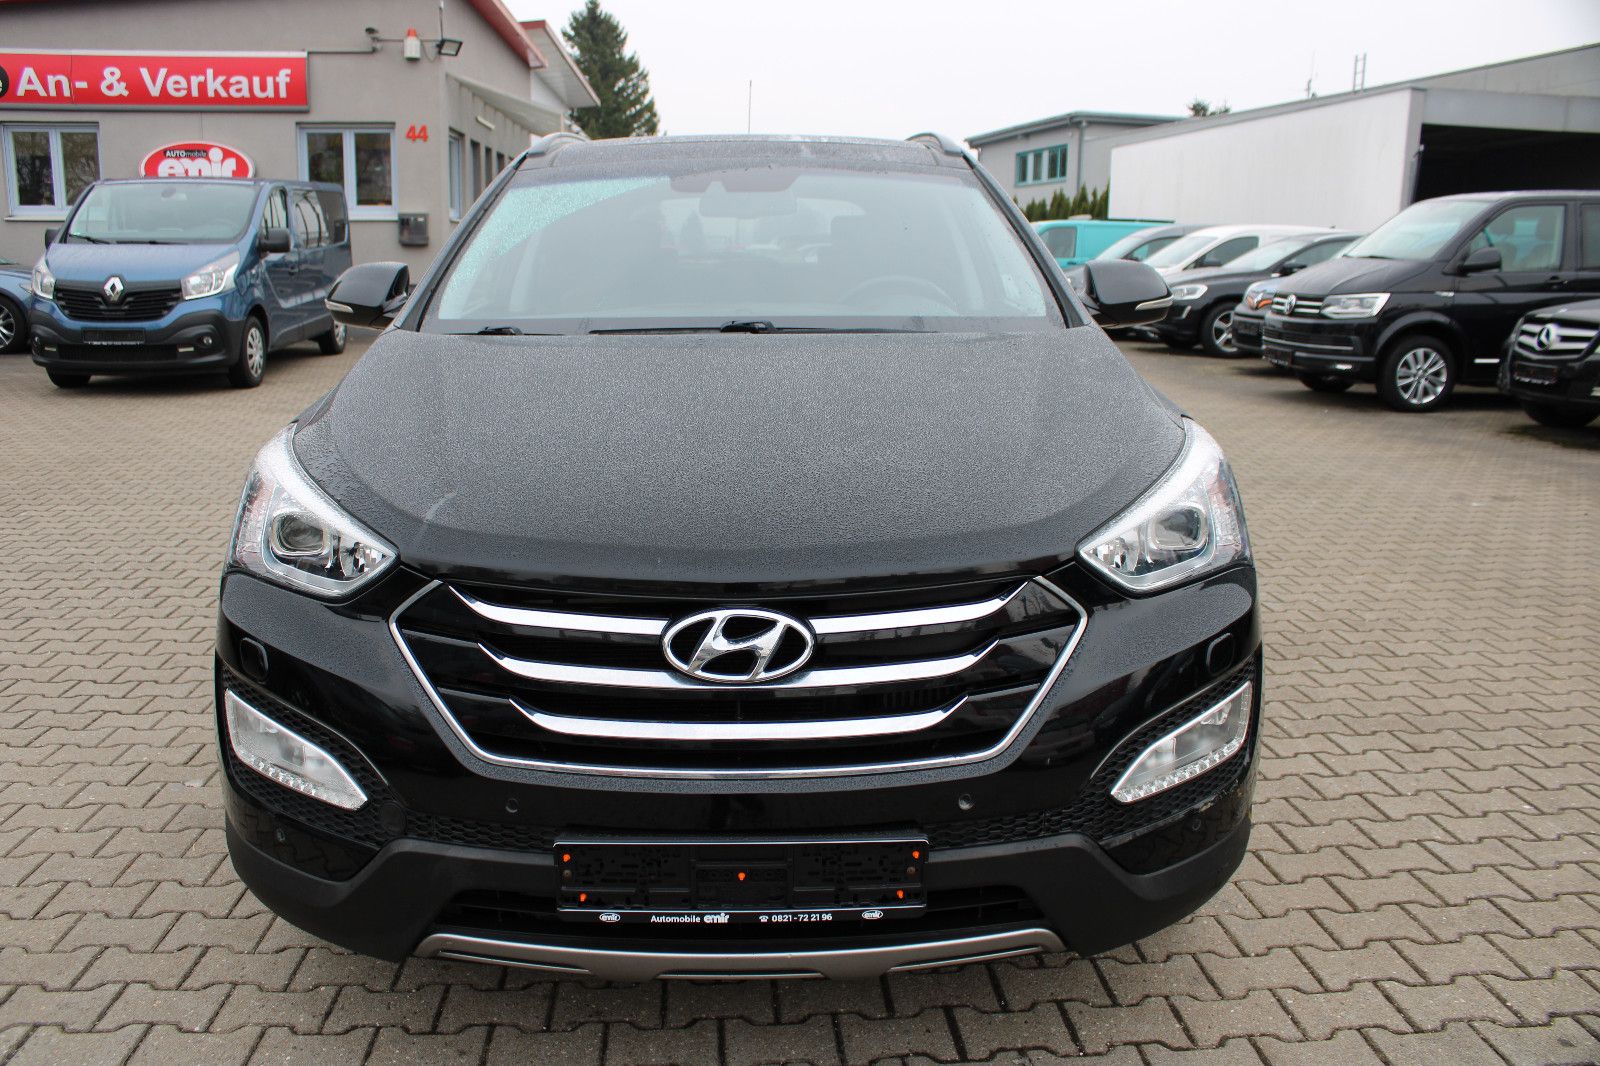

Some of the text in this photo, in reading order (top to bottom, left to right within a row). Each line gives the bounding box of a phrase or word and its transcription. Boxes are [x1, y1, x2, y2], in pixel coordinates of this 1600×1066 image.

[16, 66, 88, 97] An-
[100, 66, 129, 97] &
[139, 67, 292, 98] Verkauf
[405, 123, 428, 143] 44
[158, 147, 237, 177] emir
[650, 912, 730, 923] Automobile emir
